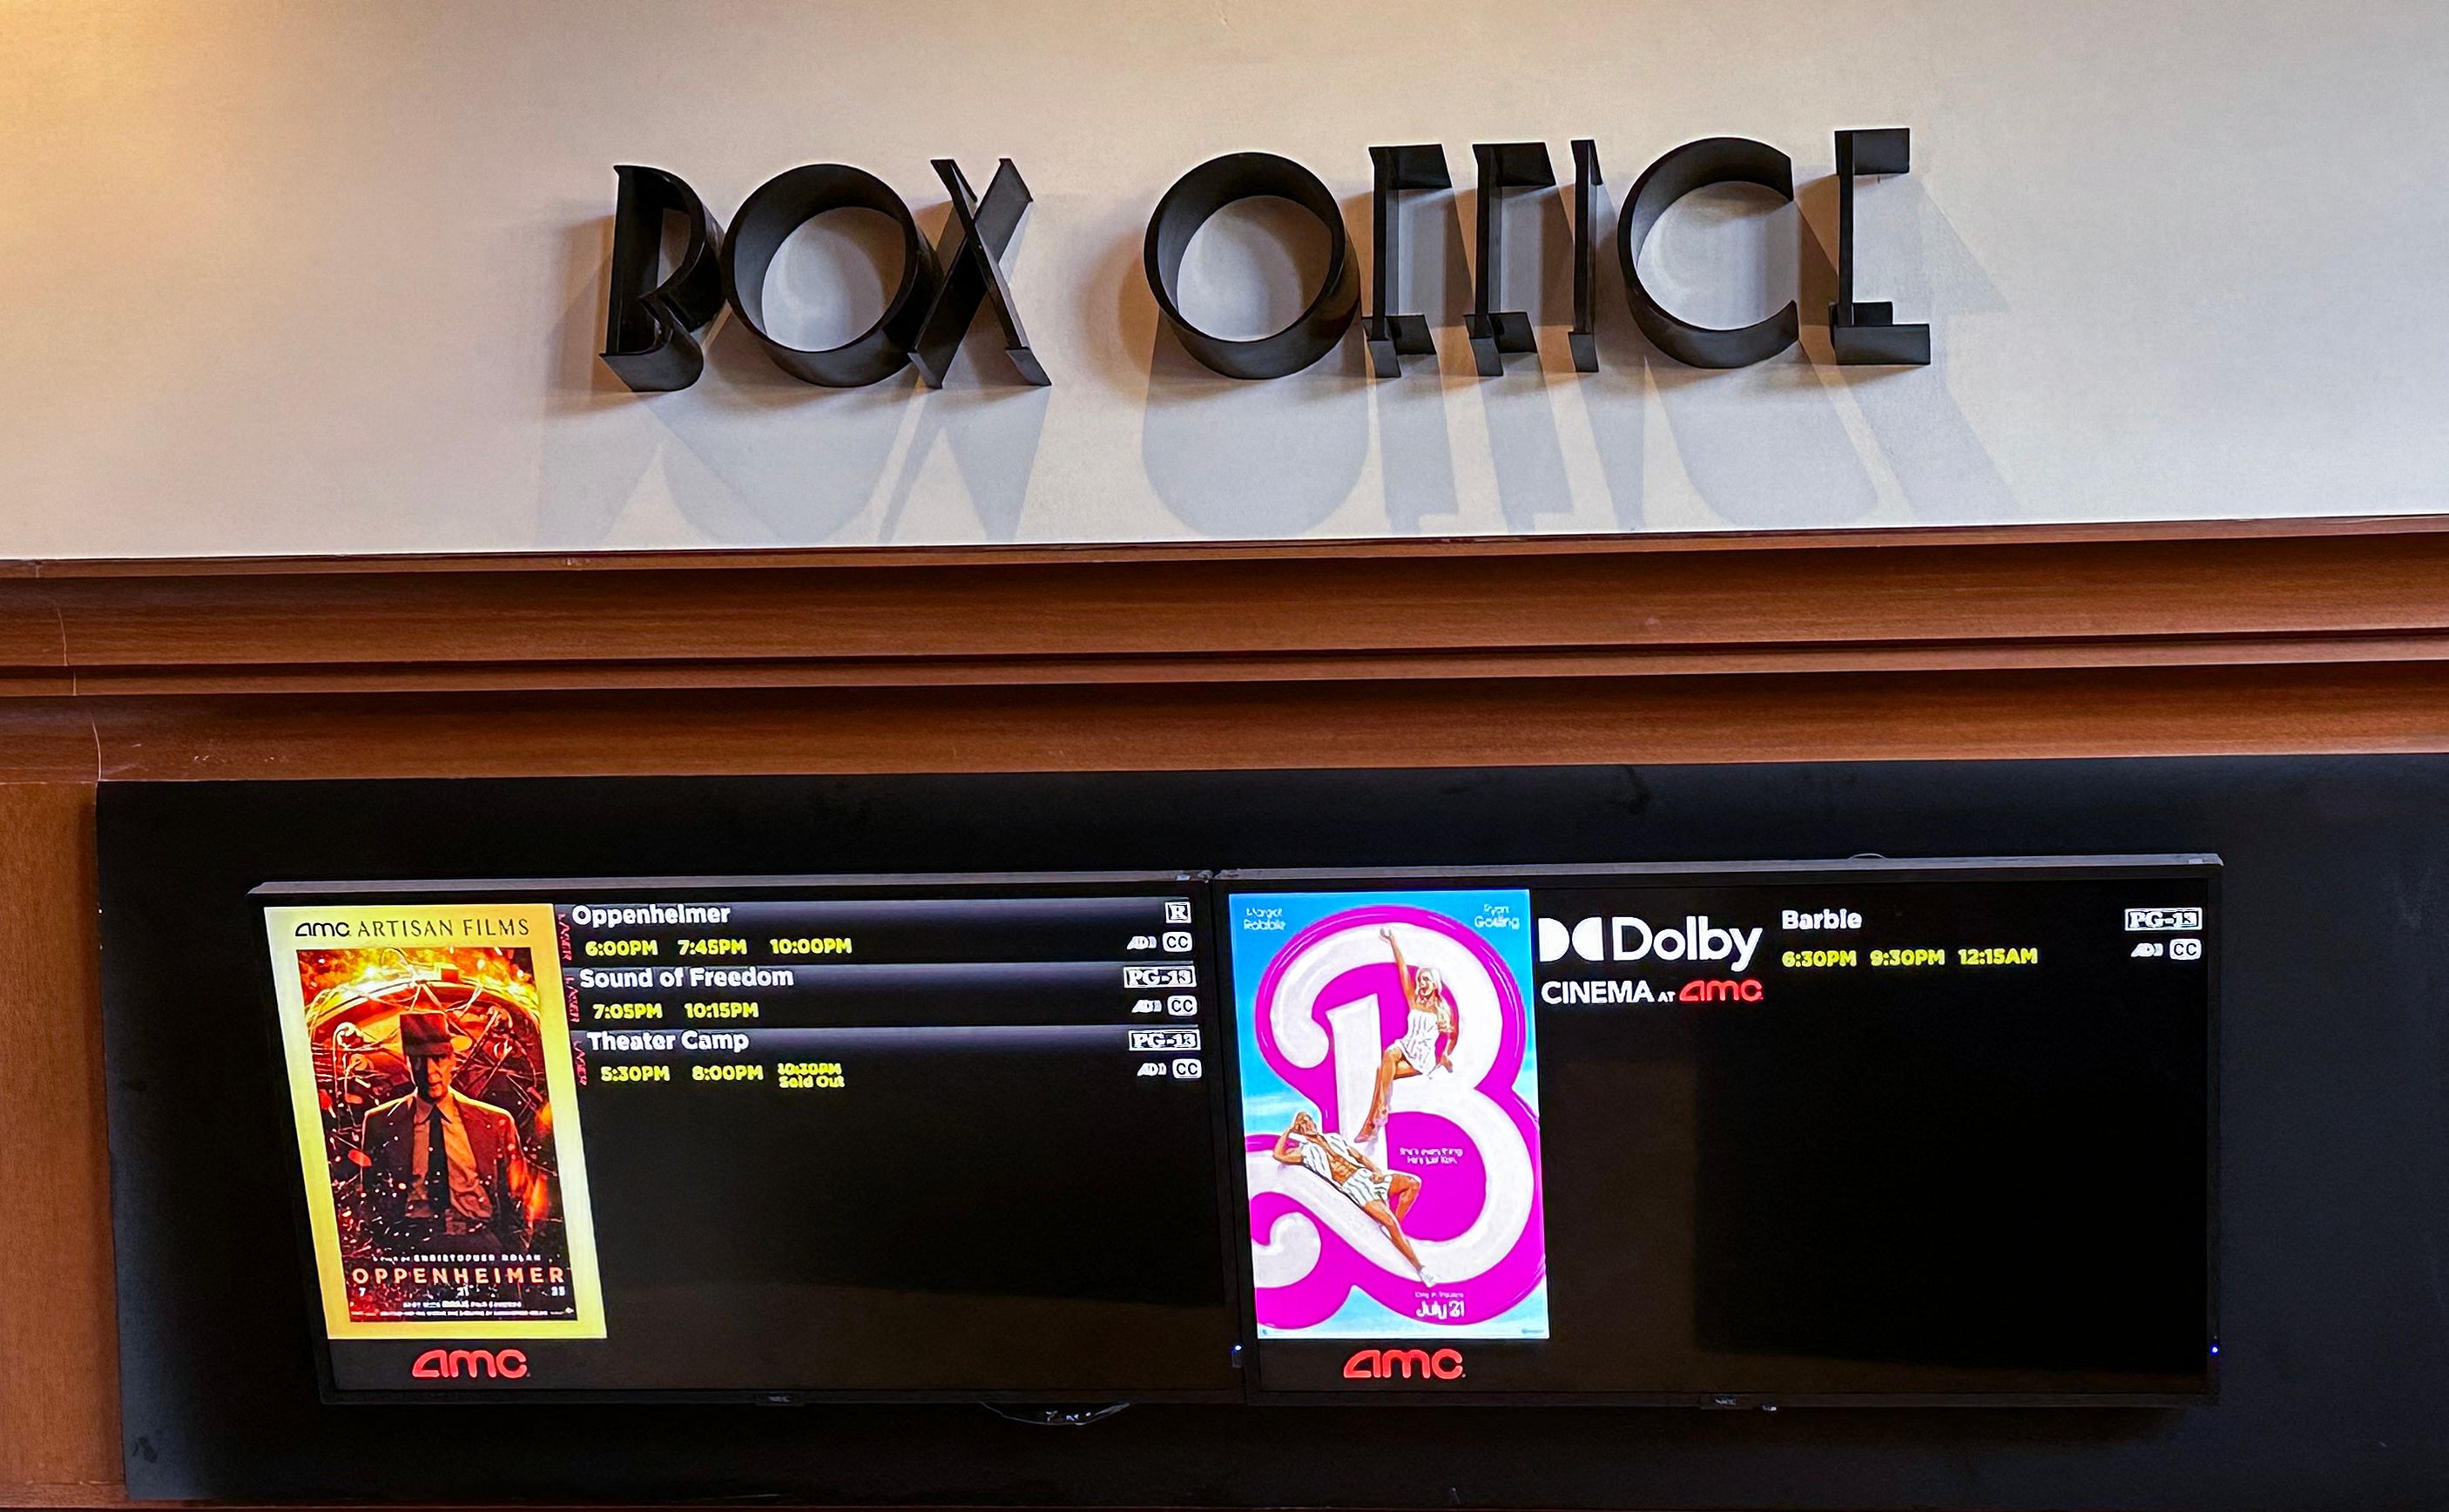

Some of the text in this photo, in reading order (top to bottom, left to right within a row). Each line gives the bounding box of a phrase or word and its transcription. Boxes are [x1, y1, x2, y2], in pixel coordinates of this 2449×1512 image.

[599, 127, 1931, 392] BOX OFFICE
[571, 904, 731, 928] Oppenheimer
[1781, 908, 1863, 930] Barbie
[2129, 911, 2197, 928] PG-13
[358, 920, 453, 937] ARTISAN
[464, 918, 530, 935] FILMS
[585, 937, 853, 956] 6:00PM 7:45PM 10:00PM
[1613, 915, 1764, 972] Dolby
[1781, 948, 2039, 968] 6:30PM 9:30PM 12:15AM
[579, 967, 795, 989] Sound of Freedom
[1126, 969, 1192, 986] PG-13
[1541, 980, 1654, 1004] CINEMA
[1658, 991, 1677, 1003] AT
[592, 1002, 759, 1019] 7:05PM 10:15PM
[586, 1030, 750, 1053] Theater Camp
[1131, 1033, 1197, 1050] PG-13
[600, 1063, 843, 1082] 5:30PM 8:00PM 10:30PM
[779, 1075, 846, 1089] Sold Out
[352, 1266, 565, 1285] OPPENHEIMER
[1416, 1299, 1466, 1320] July 21
